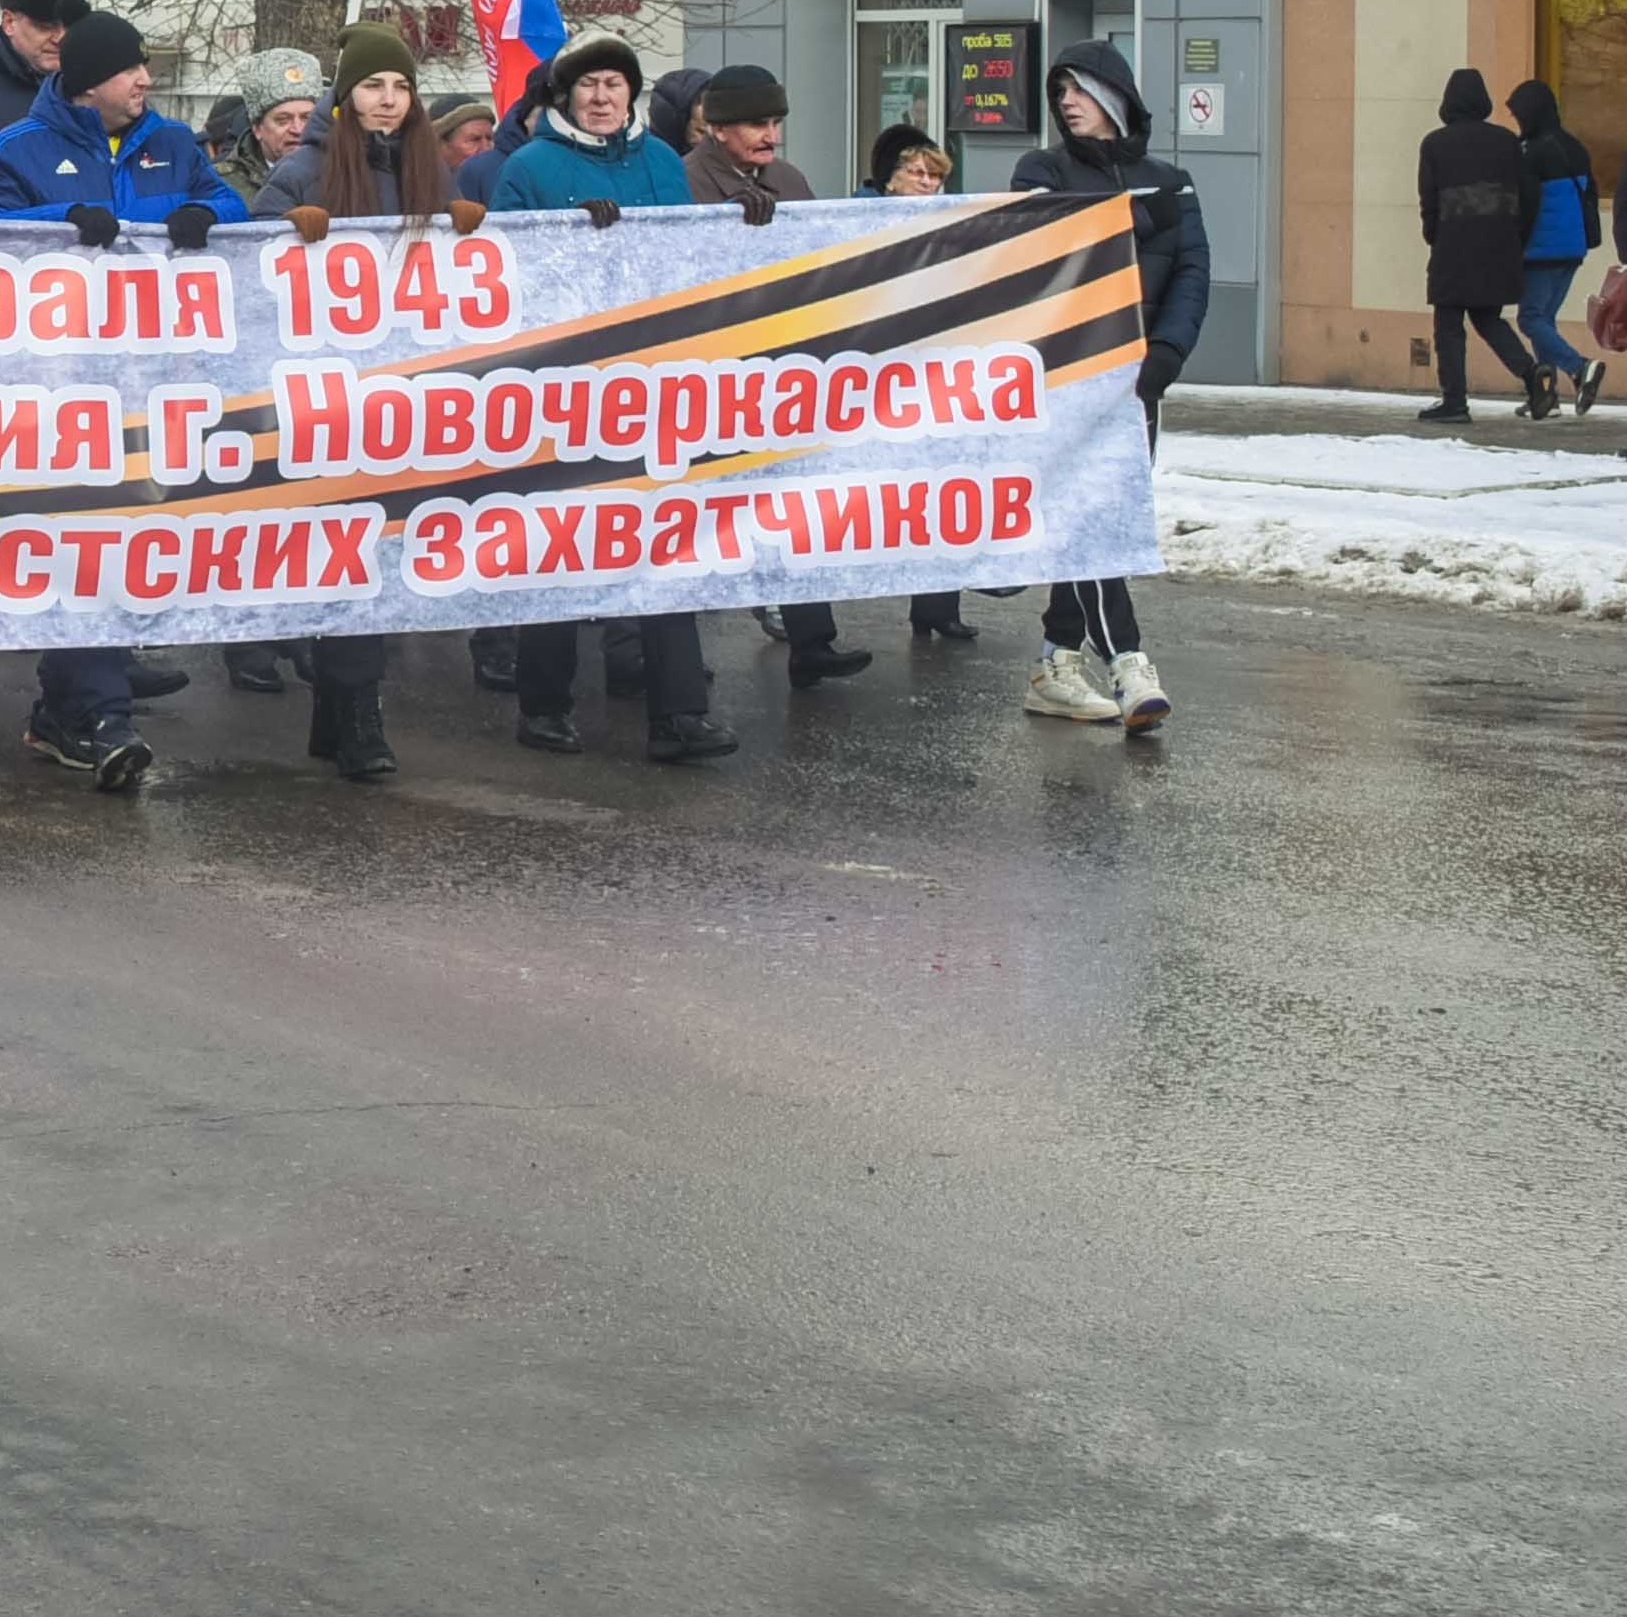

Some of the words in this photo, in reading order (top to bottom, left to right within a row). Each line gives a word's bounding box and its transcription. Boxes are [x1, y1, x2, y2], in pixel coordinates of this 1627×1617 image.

[278, 238, 510, 335] 1943
[164, 400, 254, 468] г.
[290, 357, 1036, 465] Новочеркасска
[414, 477, 1032, 580] захватчиков
